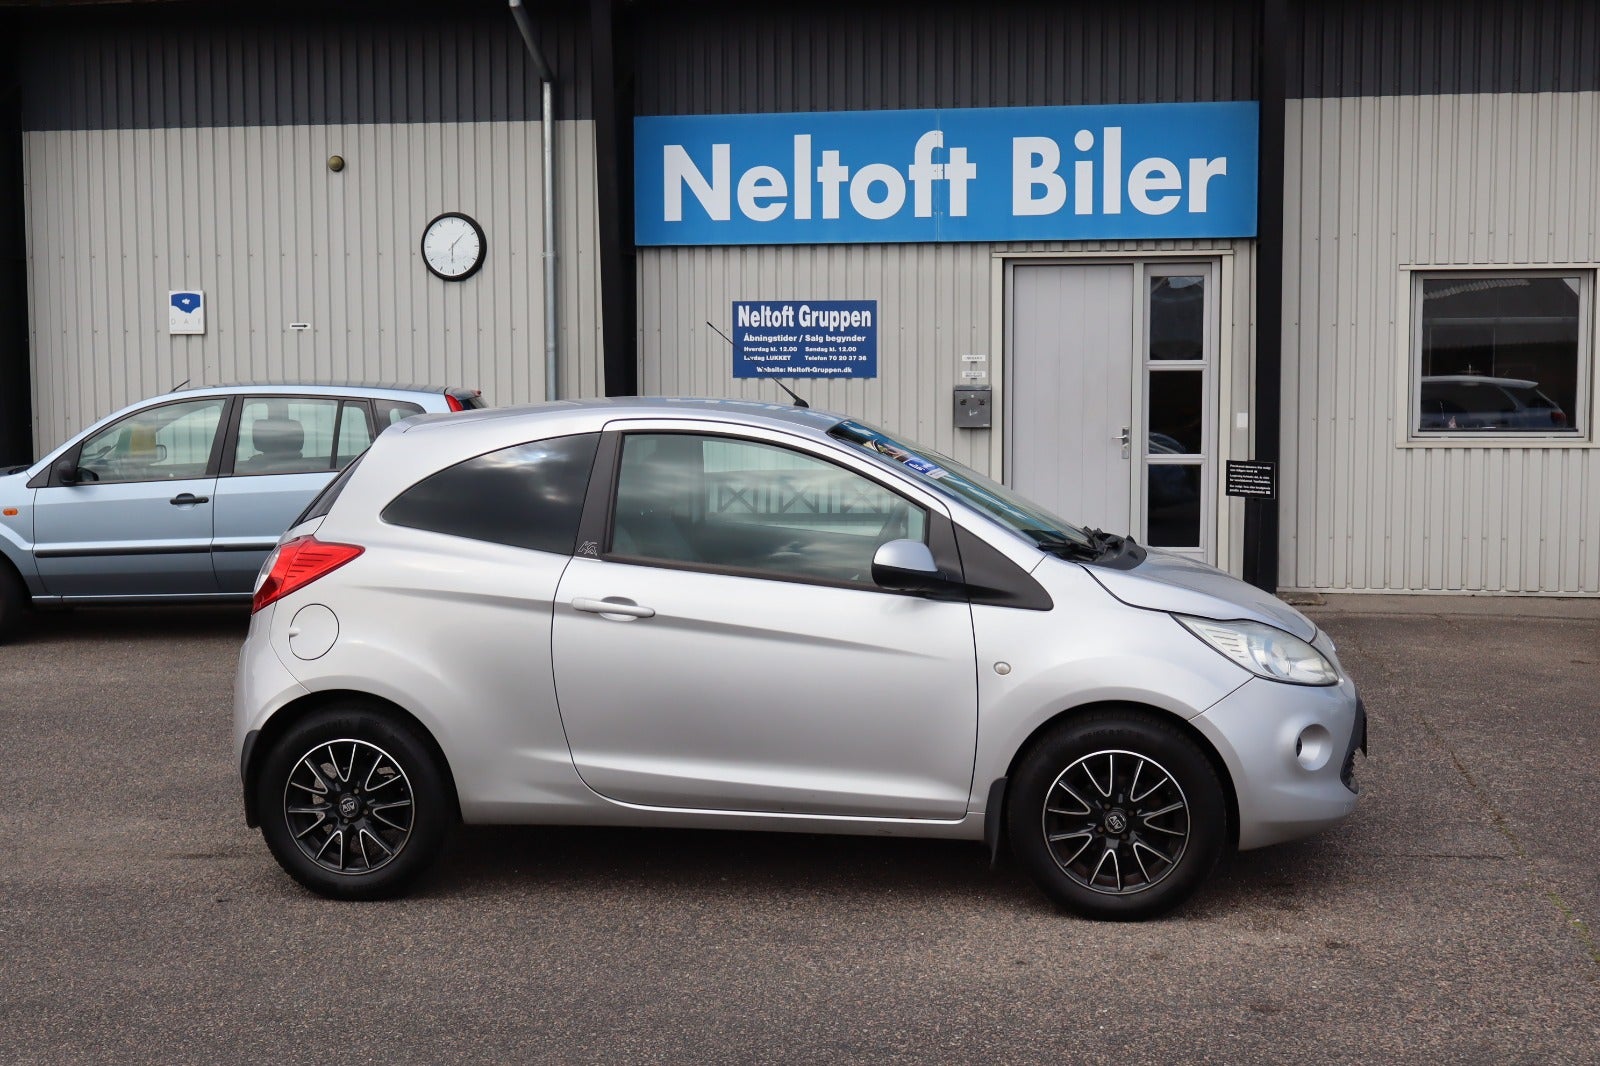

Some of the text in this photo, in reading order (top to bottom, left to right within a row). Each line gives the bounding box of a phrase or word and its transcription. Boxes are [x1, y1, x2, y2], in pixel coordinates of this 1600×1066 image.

[664, 127, 1227, 222] Neltoft Biler
[738, 305, 871, 331] Neltoft Gruppen
[743, 333, 797, 343] Åbningstider
[805, 335, 823, 343] Salg
[826, 335, 866, 343] begynder
[787, 366, 852, 374] Neltoft-Gruppen.dk
